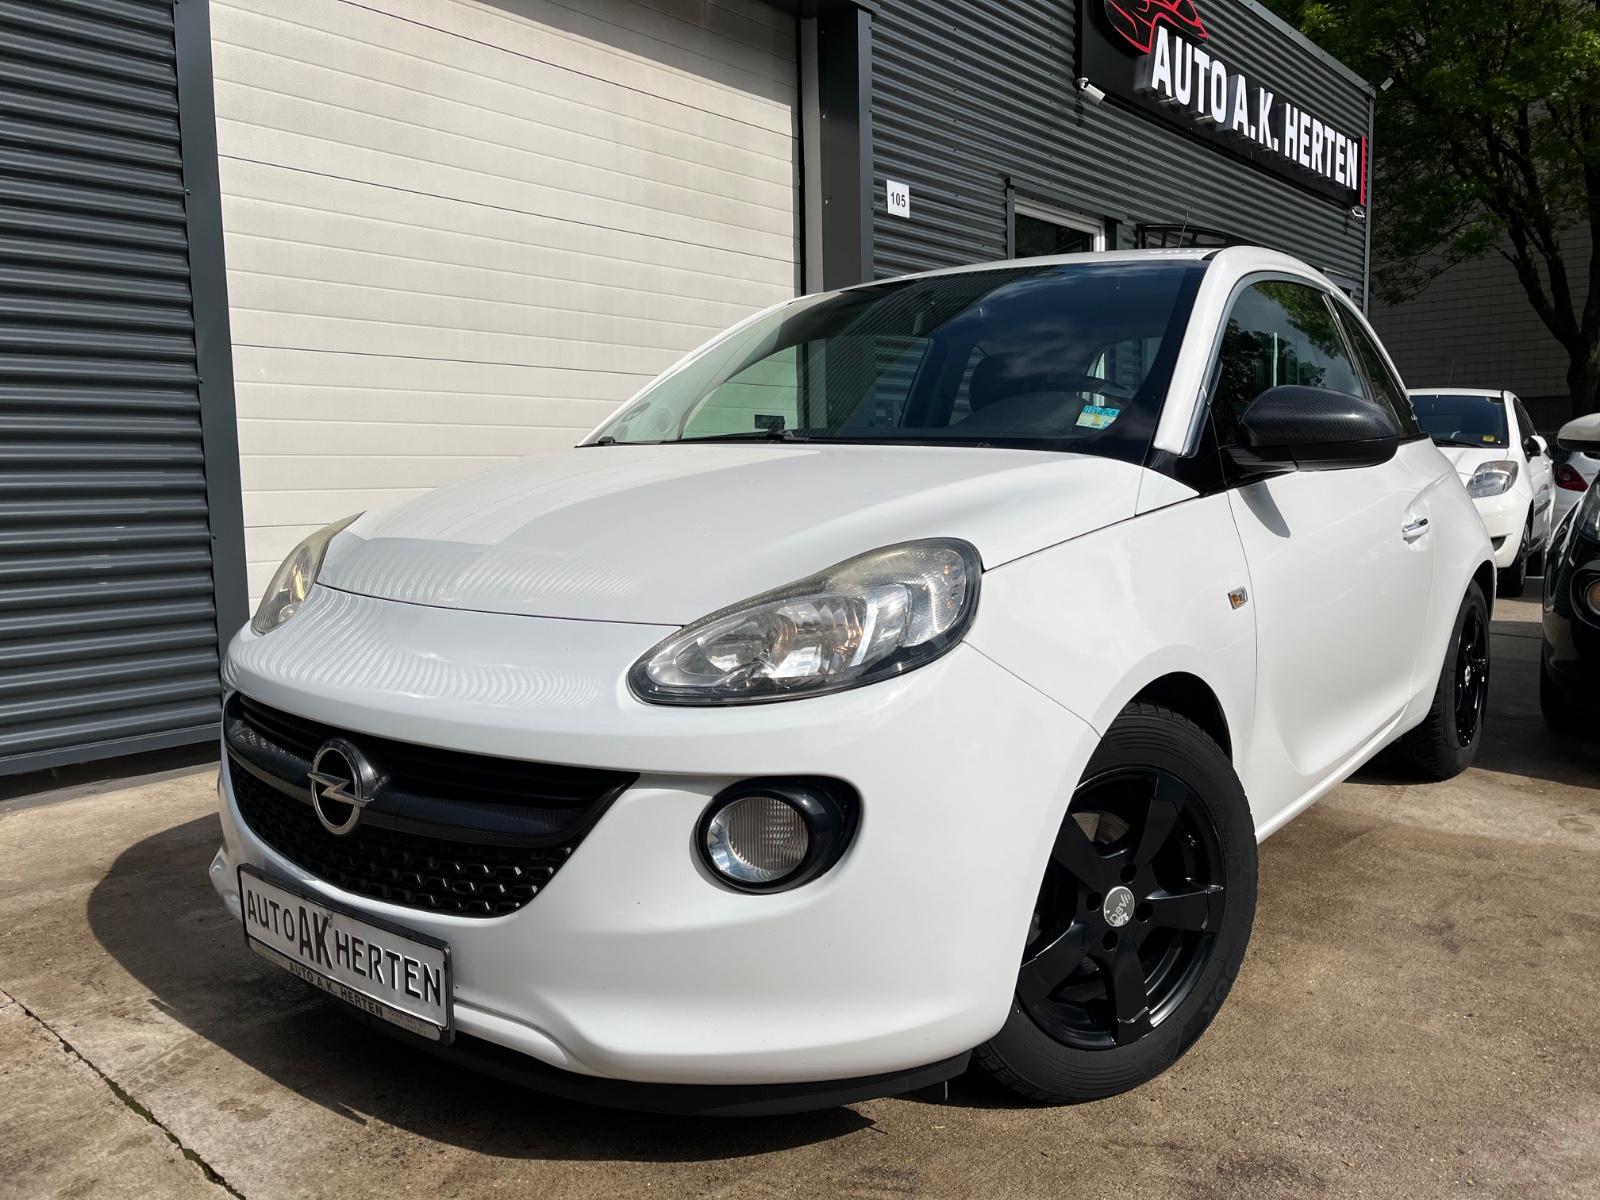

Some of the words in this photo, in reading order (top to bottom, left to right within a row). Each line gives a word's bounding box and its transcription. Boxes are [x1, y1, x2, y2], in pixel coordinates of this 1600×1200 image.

[1151, 25, 1228, 124] AUTO
[1232, 73, 1279, 152] A.K.
[1284, 102, 1358, 190] HERTEN
[890, 191, 906, 208] 105
[247, 889, 295, 943] AUTO
[299, 905, 334, 970] AK
[335, 929, 442, 1007] HERTEN
[289, 961, 314, 983] AUTO
[341, 983, 384, 1018] HERTEN
